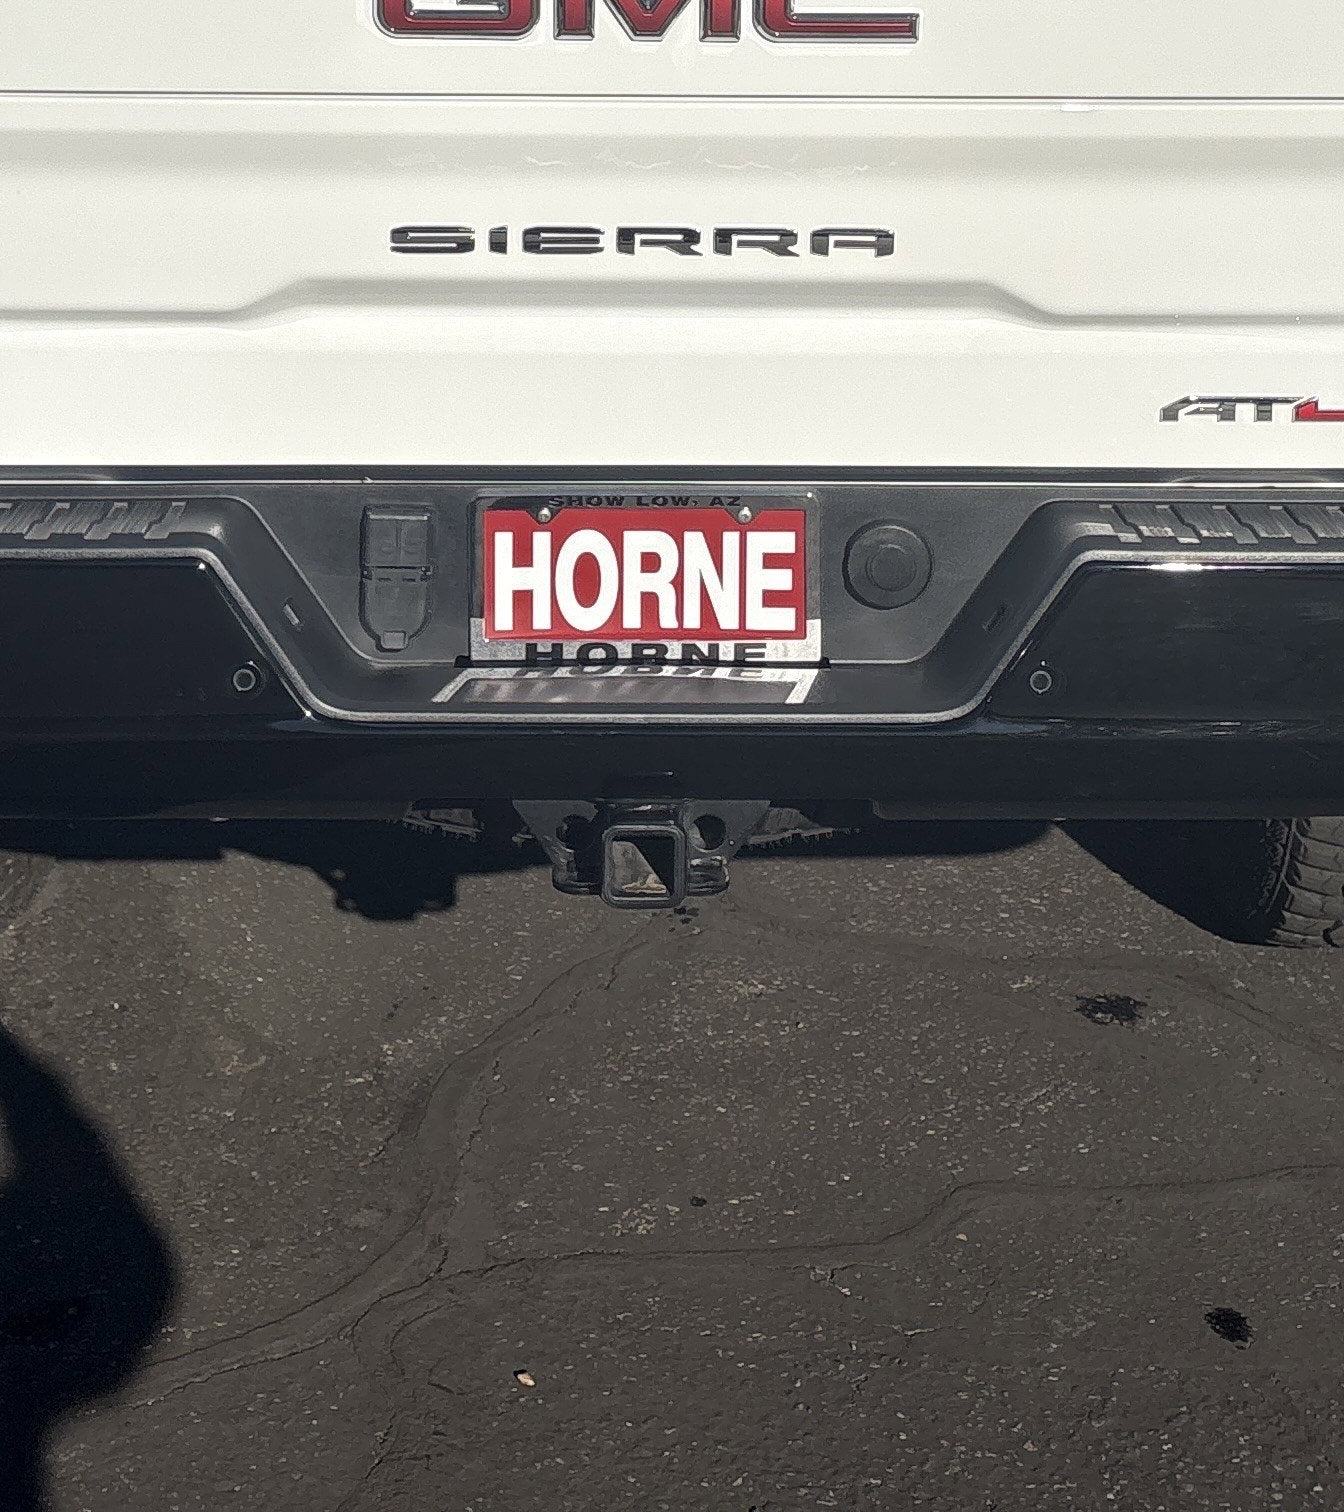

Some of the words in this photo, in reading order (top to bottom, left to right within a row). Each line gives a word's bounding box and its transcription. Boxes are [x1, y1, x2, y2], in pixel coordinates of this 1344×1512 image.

[390, 225, 895, 257] SIERRA
[548, 495, 625, 507] SHOW
[636, 495, 698, 507] LOW,
[709, 495, 741, 507] AZ
[494, 529, 797, 632] HORNE
[525, 642, 767, 666] HORNE
